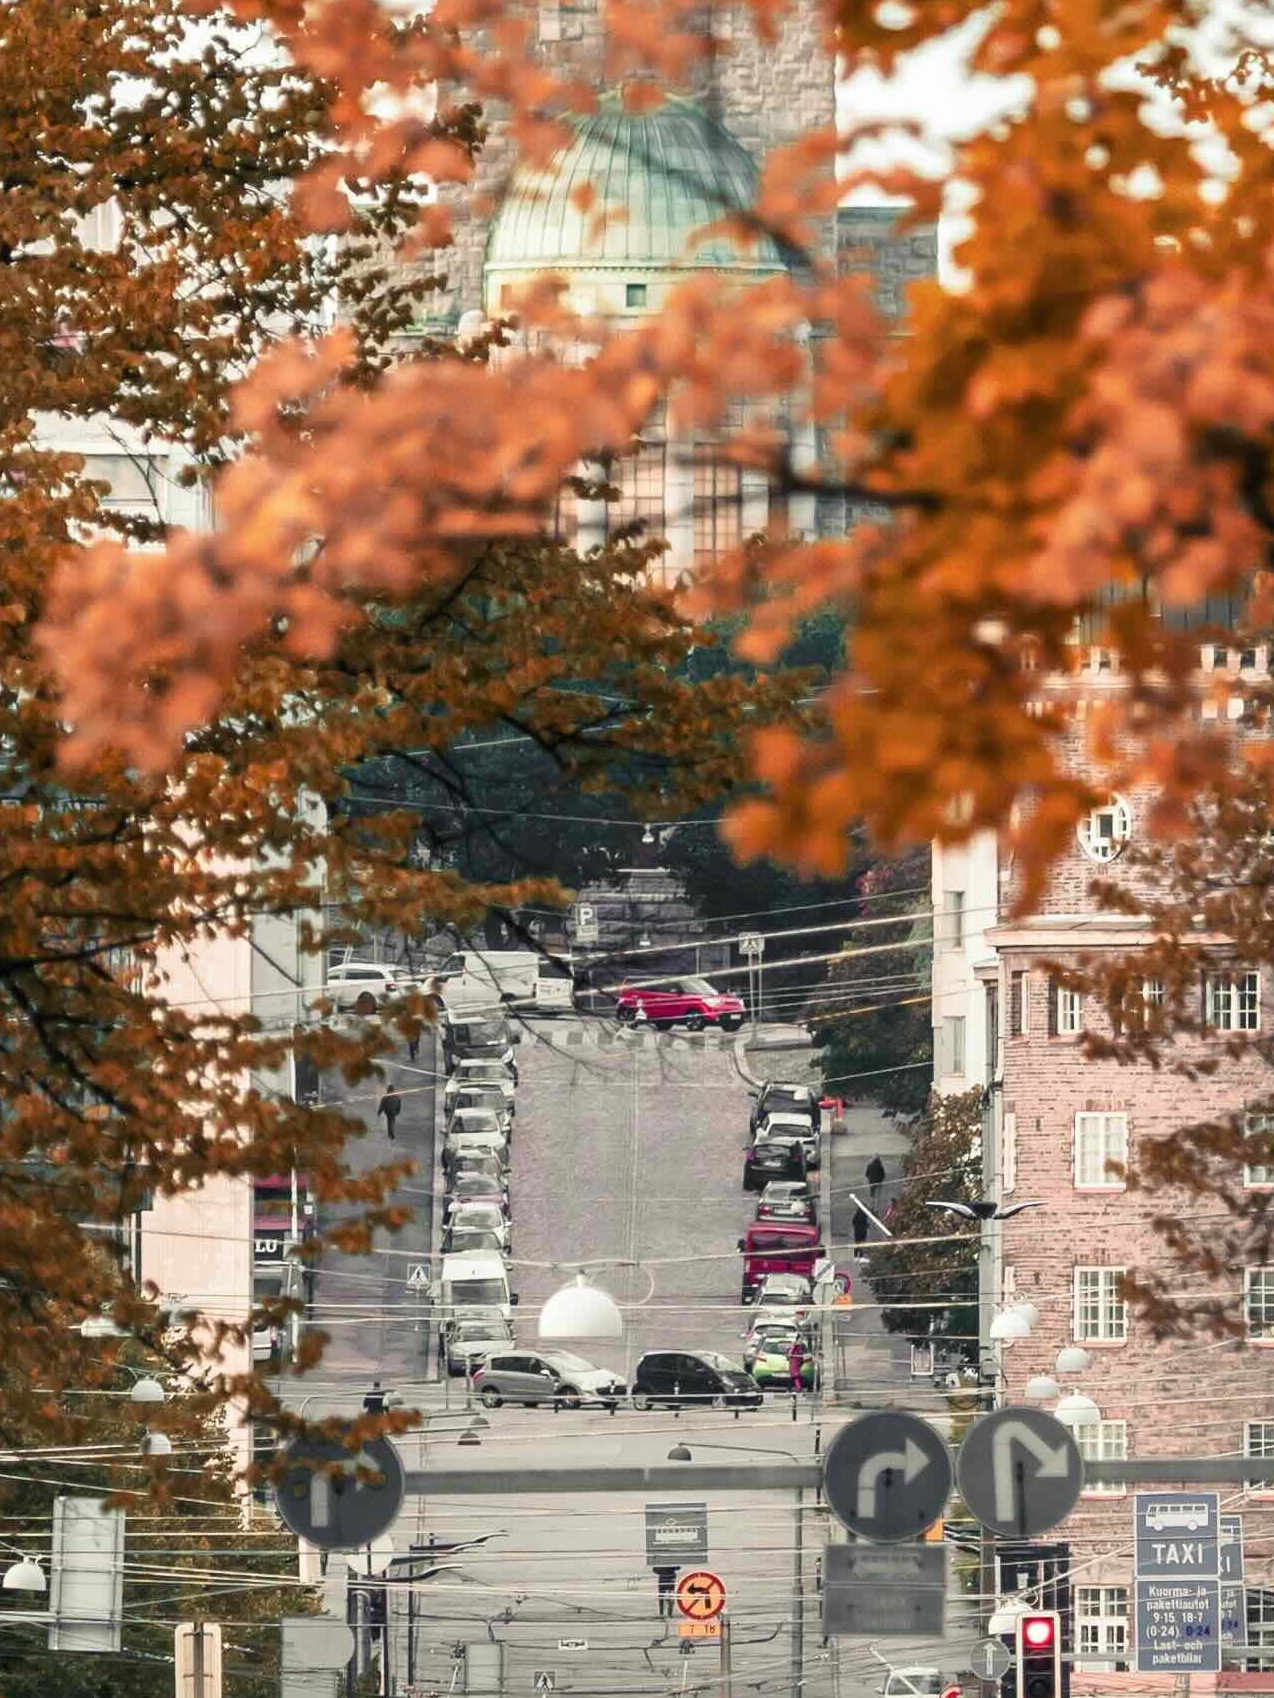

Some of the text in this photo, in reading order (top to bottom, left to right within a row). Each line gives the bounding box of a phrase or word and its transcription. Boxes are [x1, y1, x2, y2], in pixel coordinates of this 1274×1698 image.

[580, 907, 593, 926] P
[1151, 1543, 1204, 1565] TAXI
[1197, 1586, 1208, 1600] ja
[1146, 1597, 1210, 1611] pakettiautot
[1182, 1612, 1204, 1624] 18-7
[1185, 1625, 1212, 1637] 0-24
[1183, 1639, 1204, 1652] och
